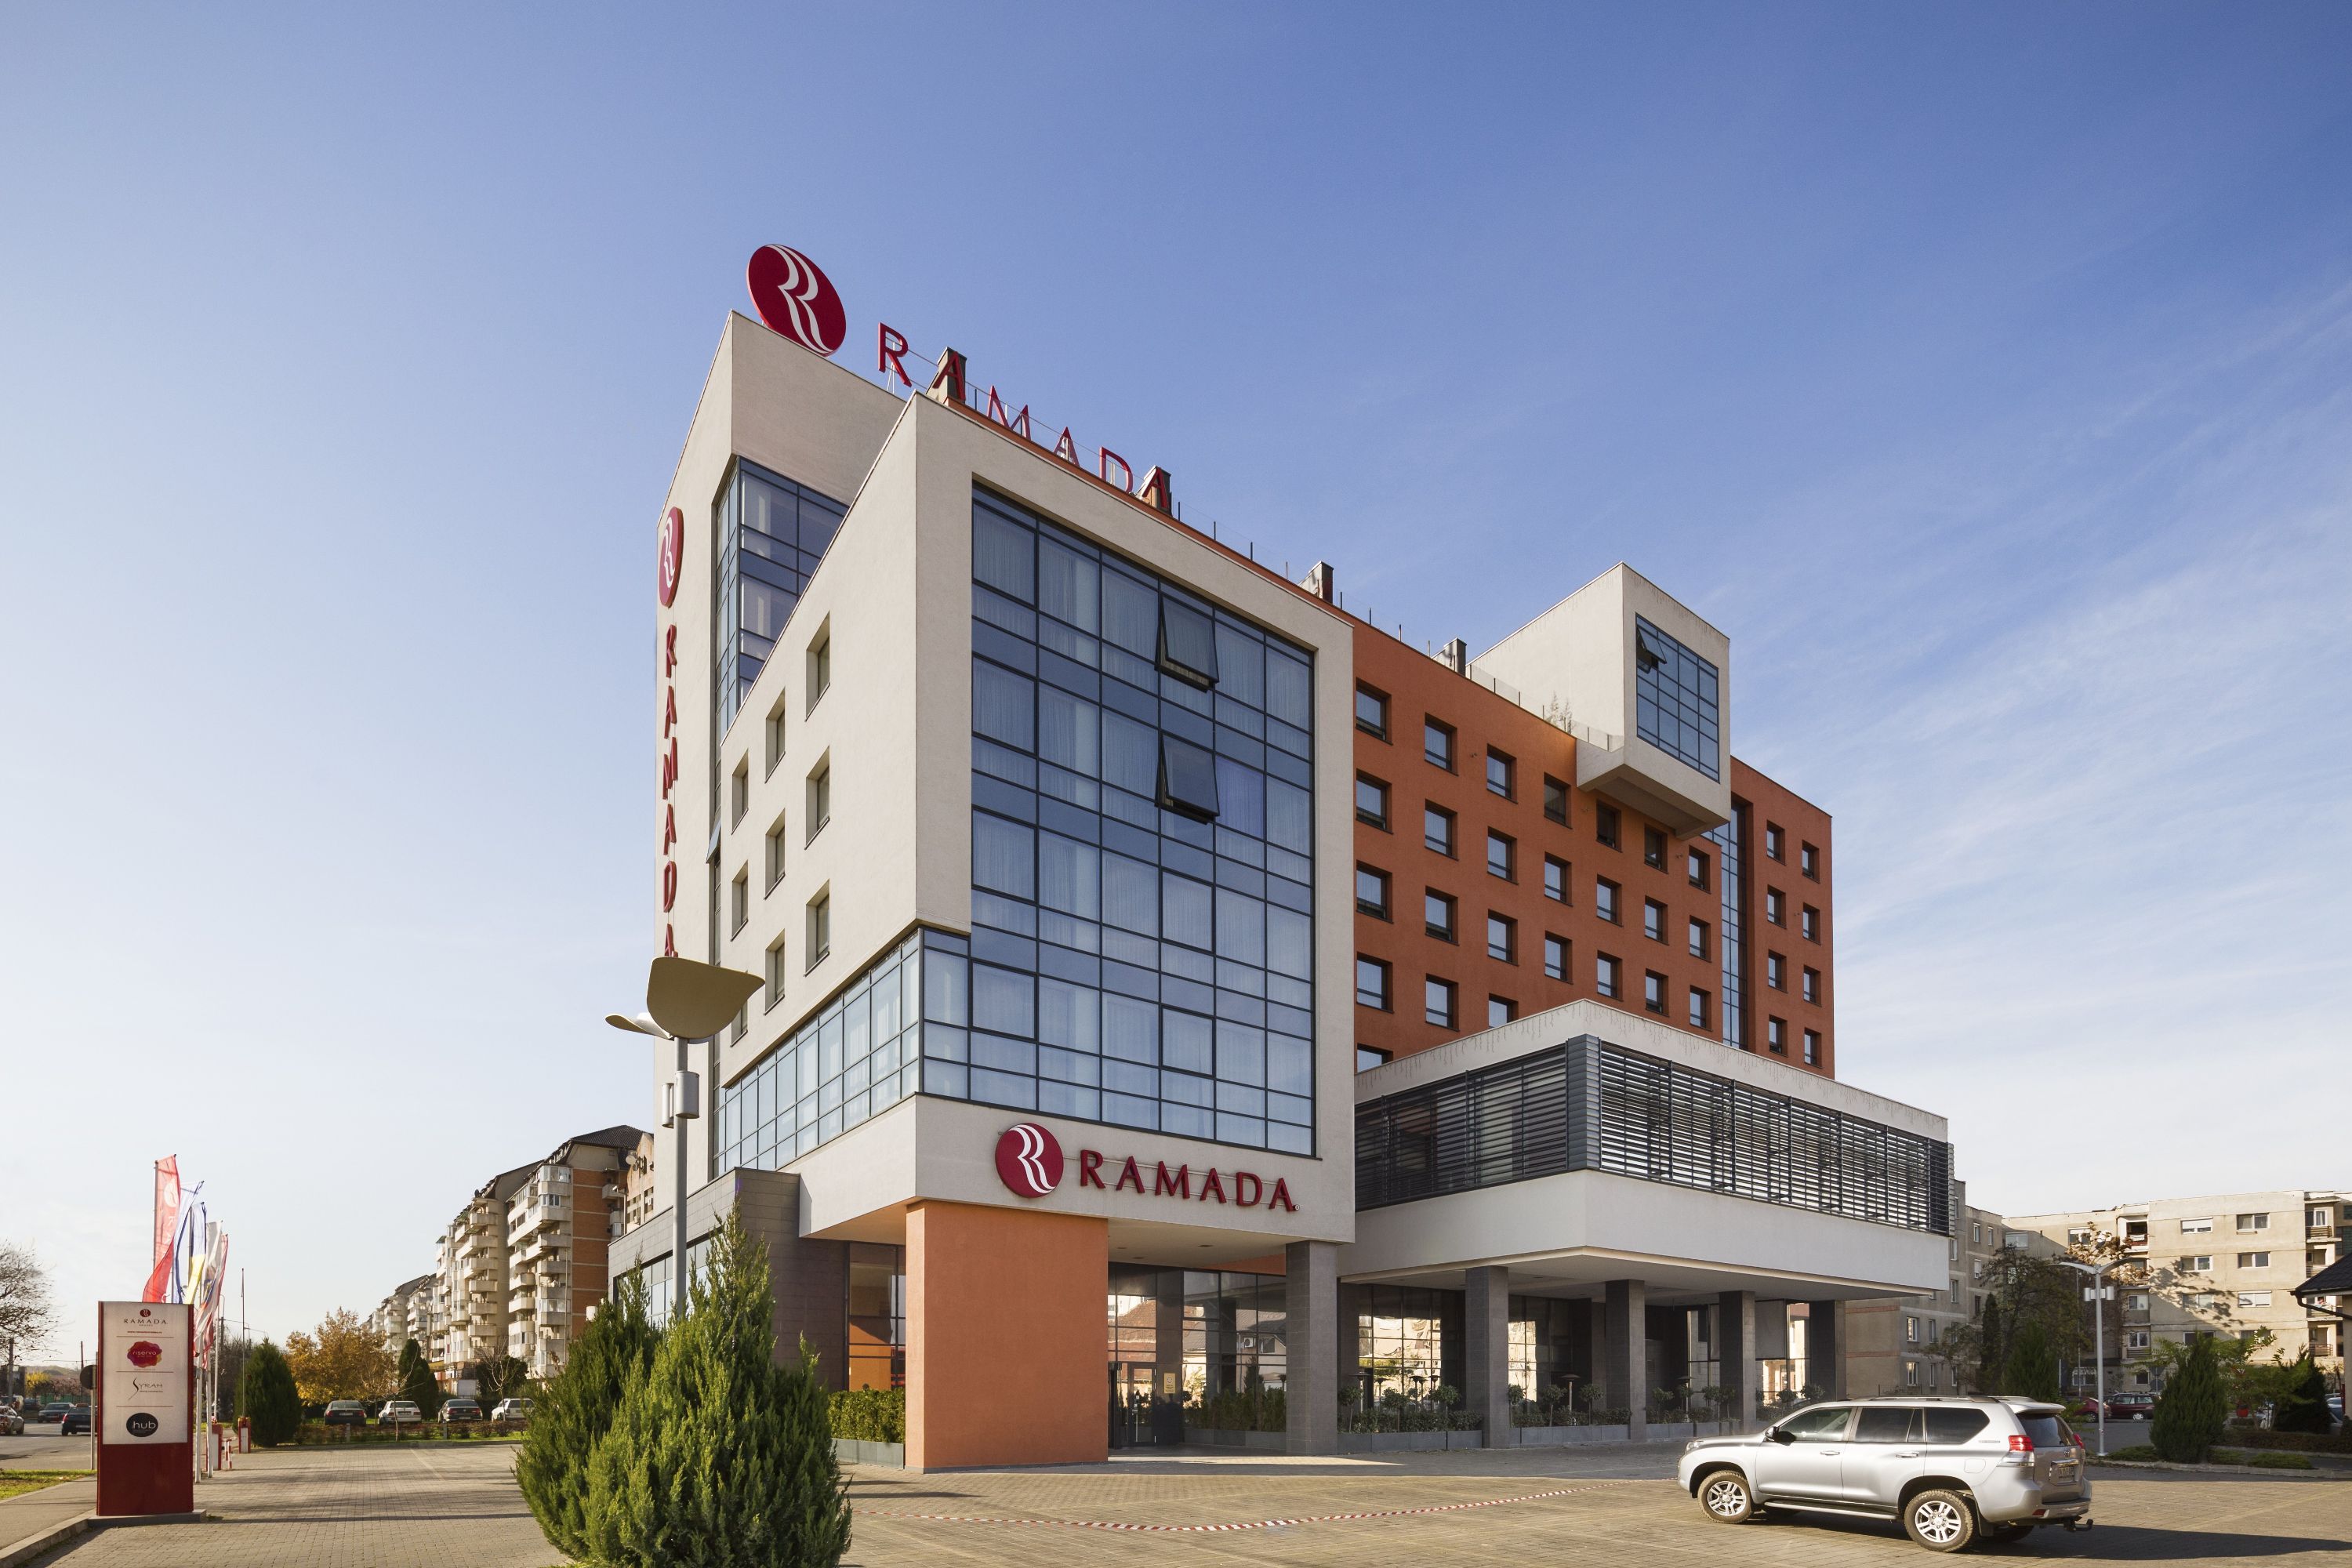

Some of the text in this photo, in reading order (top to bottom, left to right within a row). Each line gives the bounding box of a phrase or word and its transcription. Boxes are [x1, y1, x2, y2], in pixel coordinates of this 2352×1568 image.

[878, 322, 1172, 510] RAMADA
[662, 624, 678, 957] RAMADA
[1080, 1149, 1295, 1212] RAMADA
[132, 1421, 156, 1429] hub
